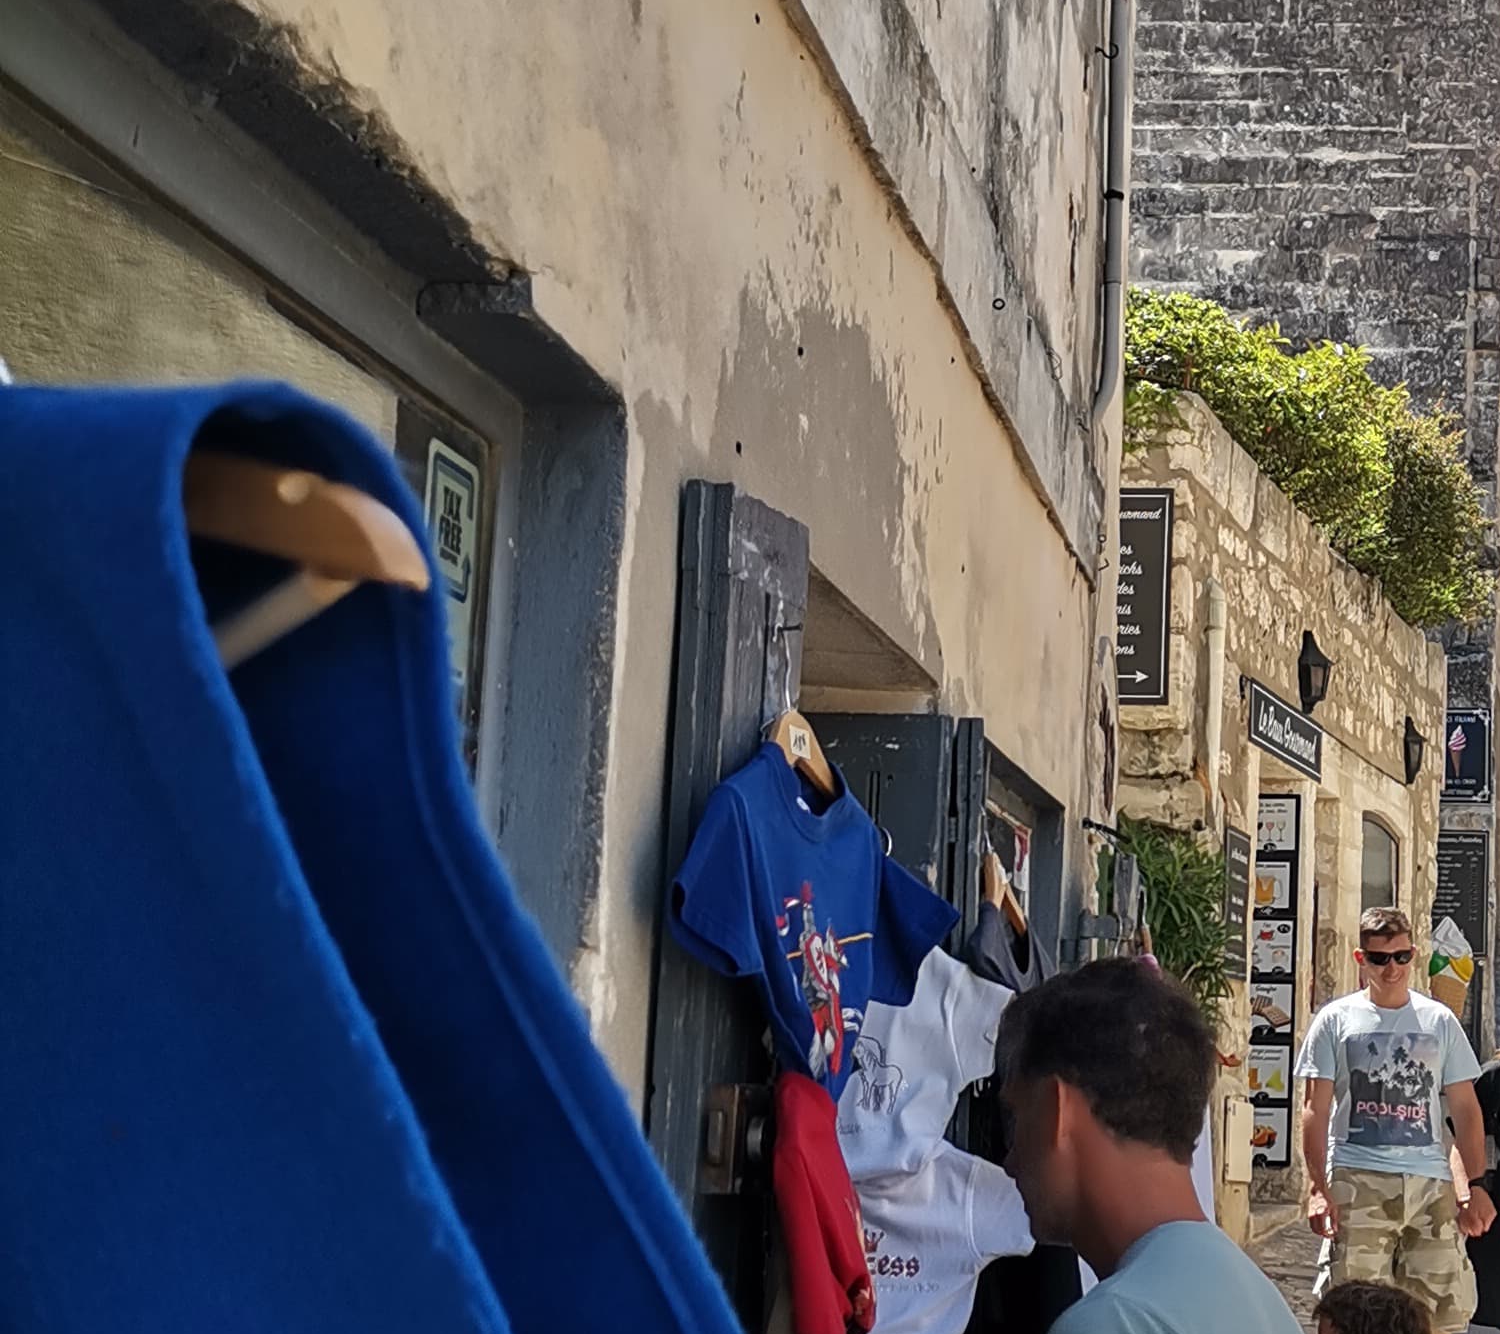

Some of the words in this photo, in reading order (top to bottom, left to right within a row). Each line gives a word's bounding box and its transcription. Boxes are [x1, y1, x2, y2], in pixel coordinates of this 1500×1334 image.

[443, 485, 463, 524] TAX
[1119, 508, 1162, 520] urmand
[439, 513, 463, 556] FREE
[1356, 1100, 1427, 1123] POOLSIDE
